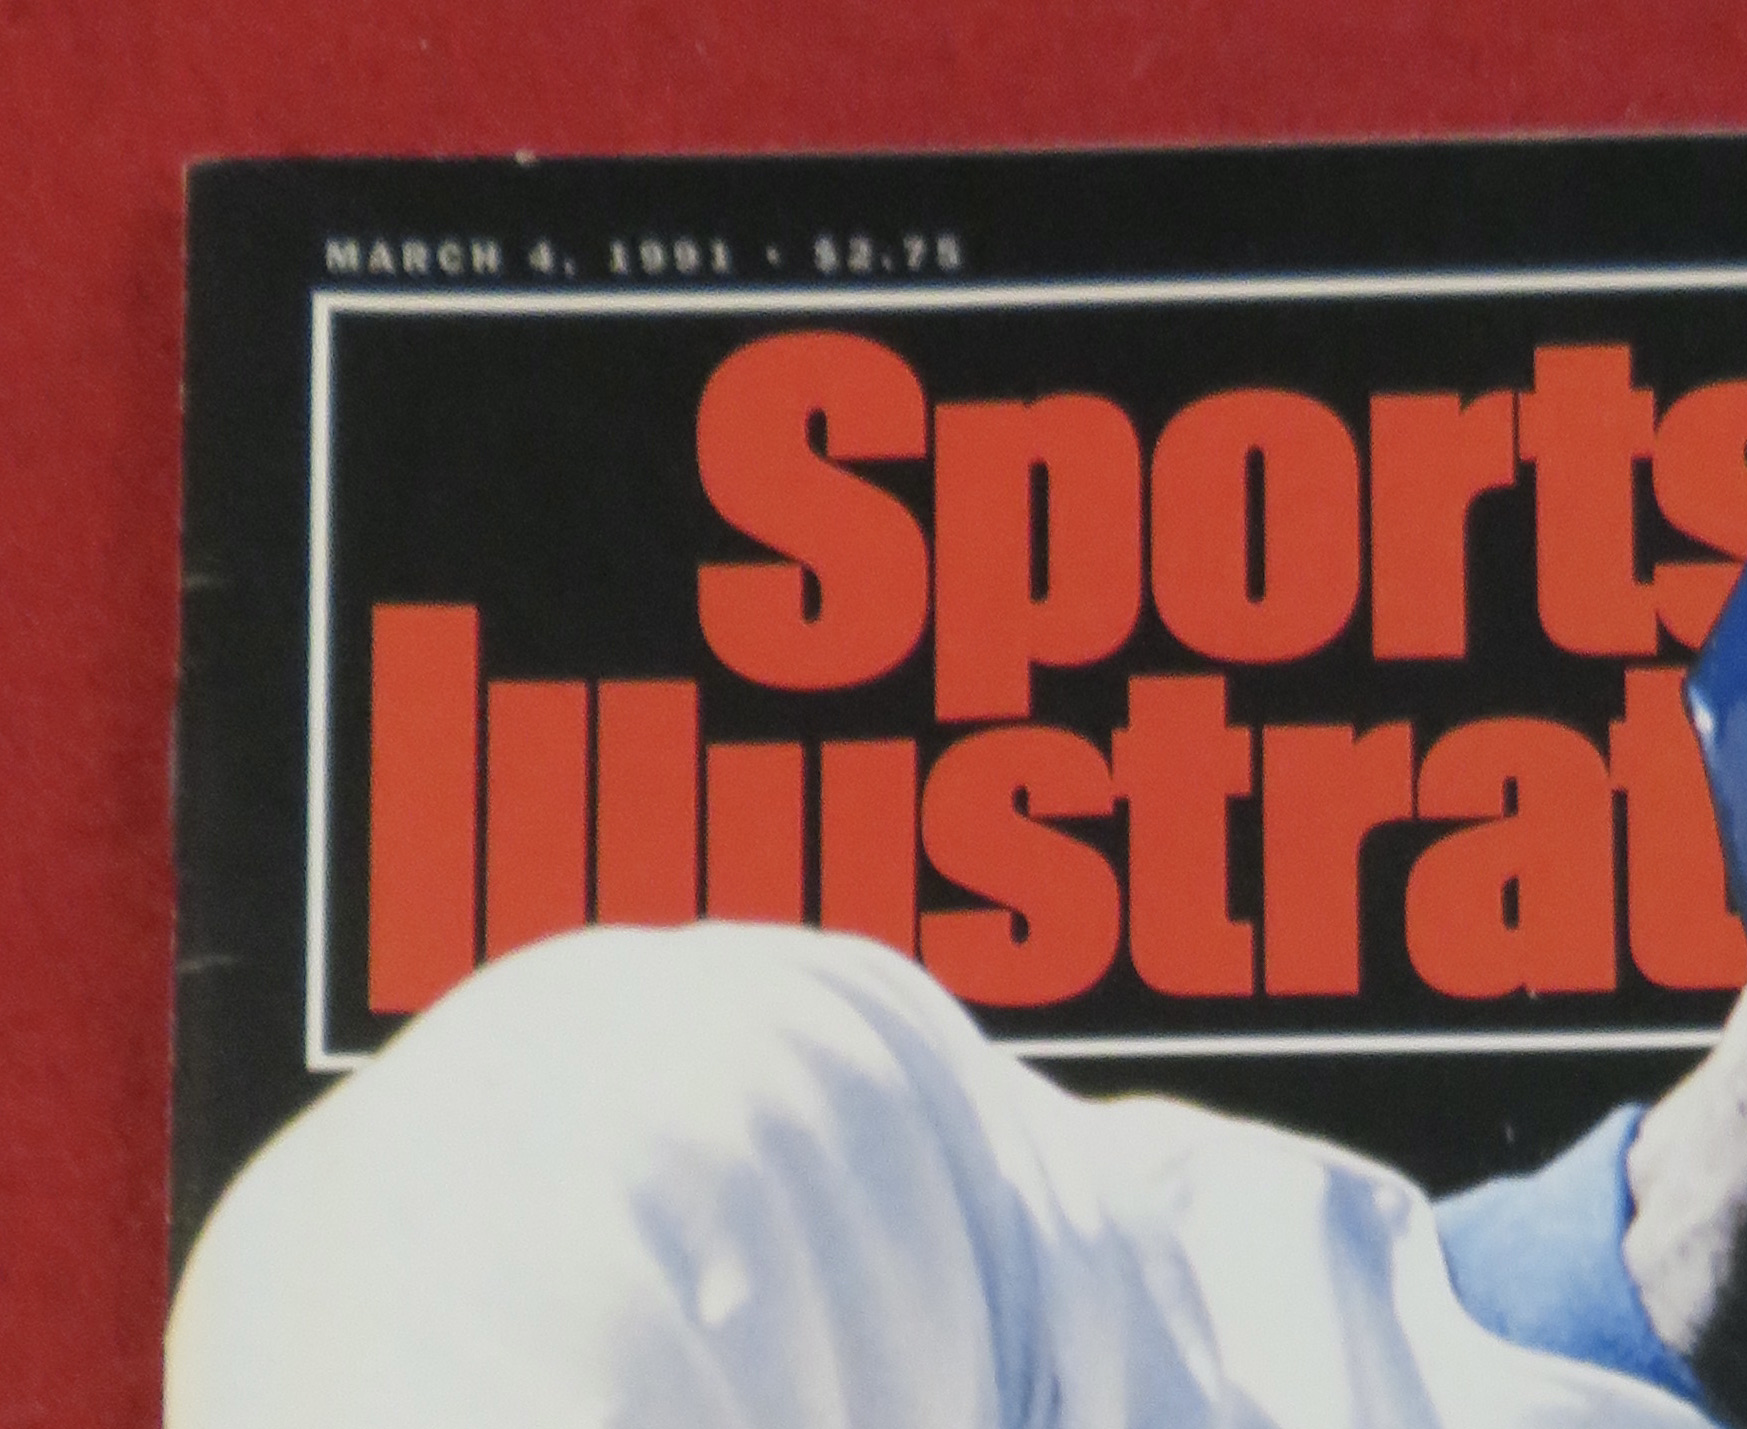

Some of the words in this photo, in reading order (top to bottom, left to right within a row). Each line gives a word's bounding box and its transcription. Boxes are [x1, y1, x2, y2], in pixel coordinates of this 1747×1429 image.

[324, 238, 503, 276] MARCH
[529, 239, 578, 278] 4,
[609, 236, 733, 276] 1991
[812, 234, 965, 275] $2.75
